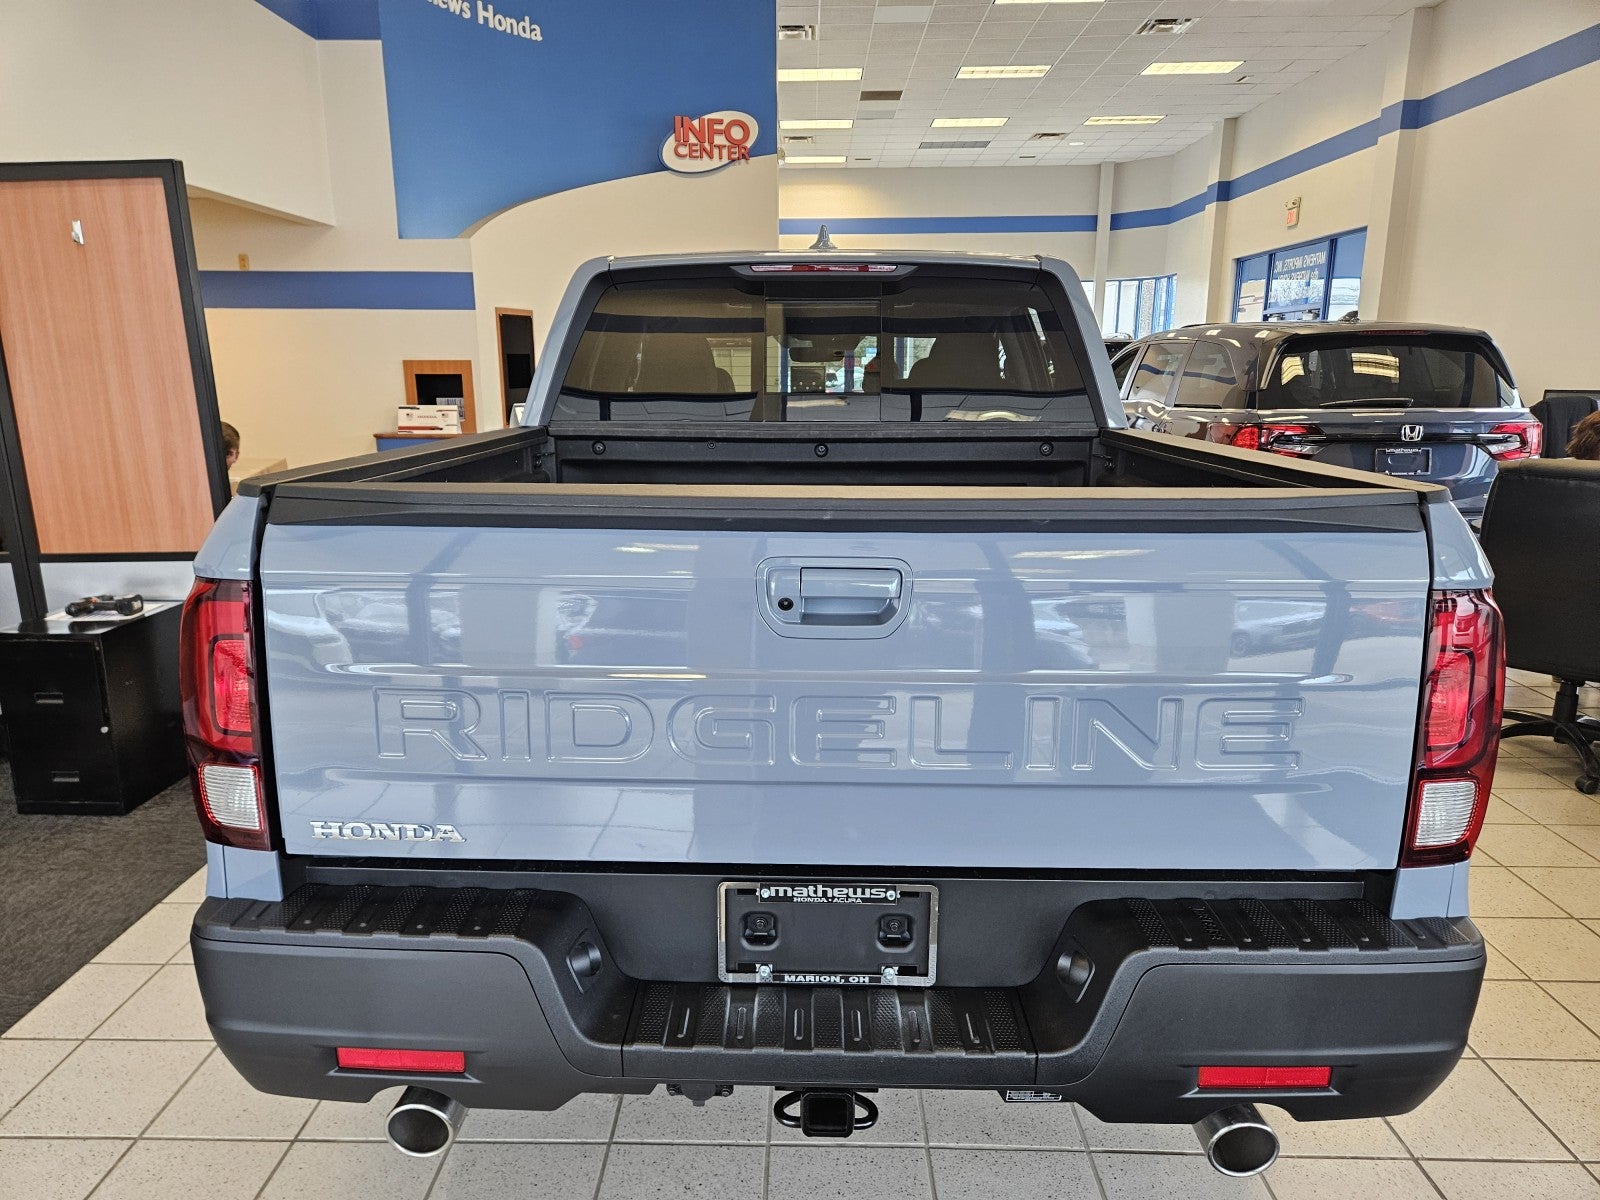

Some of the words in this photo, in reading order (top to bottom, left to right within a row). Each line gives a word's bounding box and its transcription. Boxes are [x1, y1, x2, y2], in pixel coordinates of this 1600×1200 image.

[477, 0, 542, 41] Honda
[674, 115, 750, 145] INFO
[674, 142, 750, 161] CENTER
[372, 686, 1305, 771] RIDGELINE
[310, 821, 467, 842] HONDA
[770, 885, 886, 898] mathews
[784, 975, 845, 984] MARION,
